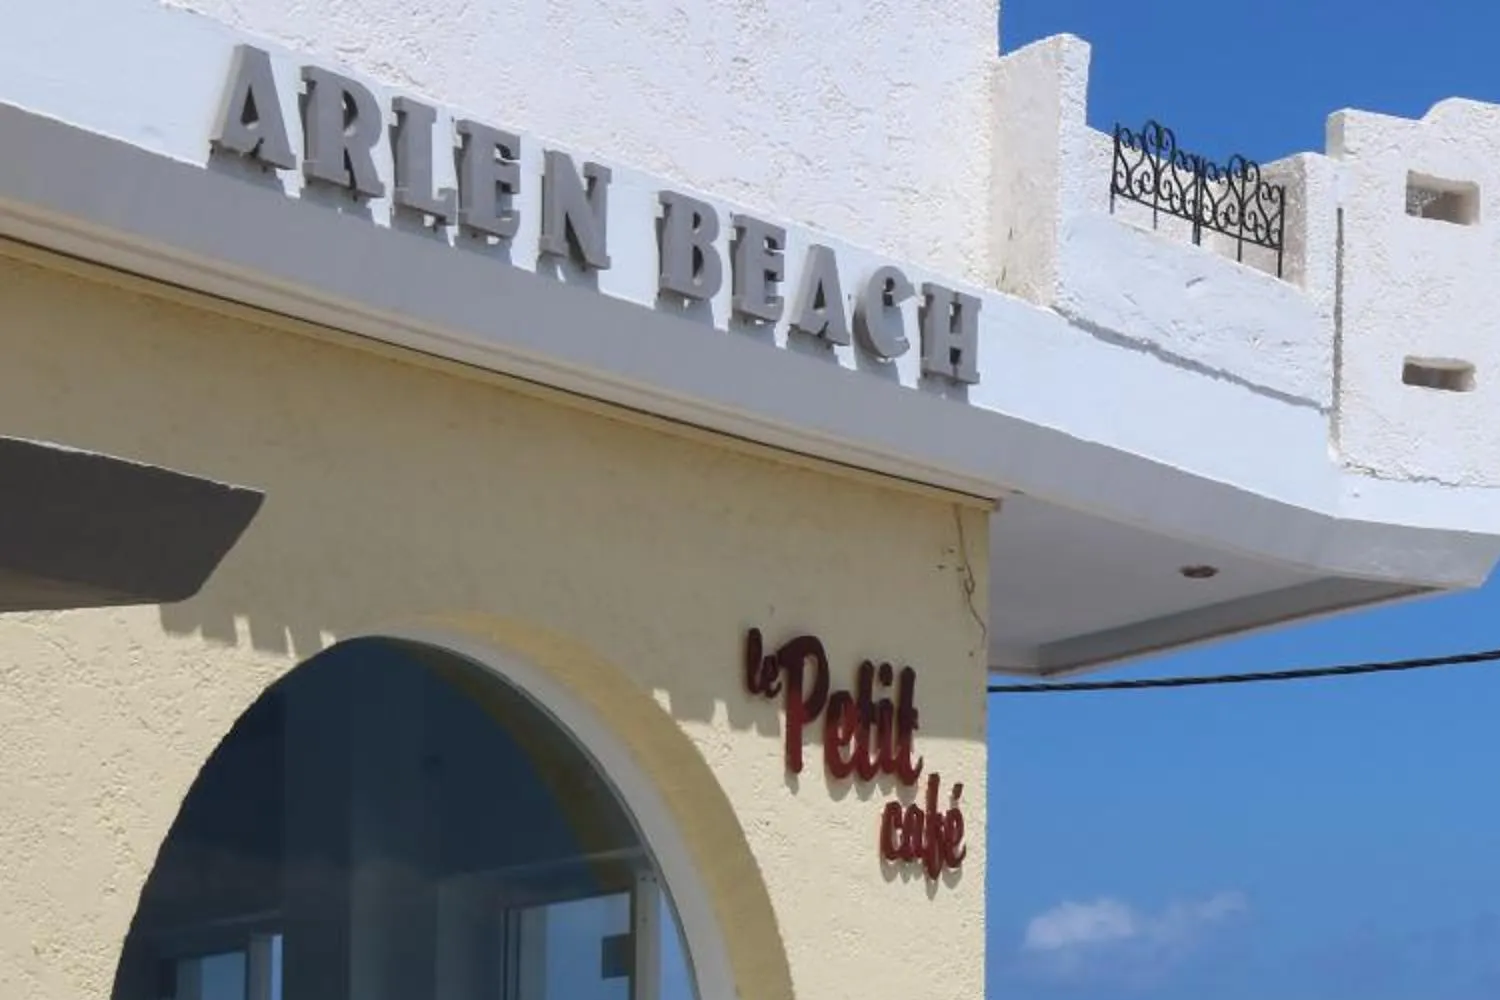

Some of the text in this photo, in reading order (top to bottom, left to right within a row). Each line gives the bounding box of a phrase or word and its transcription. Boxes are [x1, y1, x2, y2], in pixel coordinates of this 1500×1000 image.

[209, 44, 982, 385] ARLEN BEACH
[747, 627, 923, 786] le Petit
[880, 772, 967, 880] café
